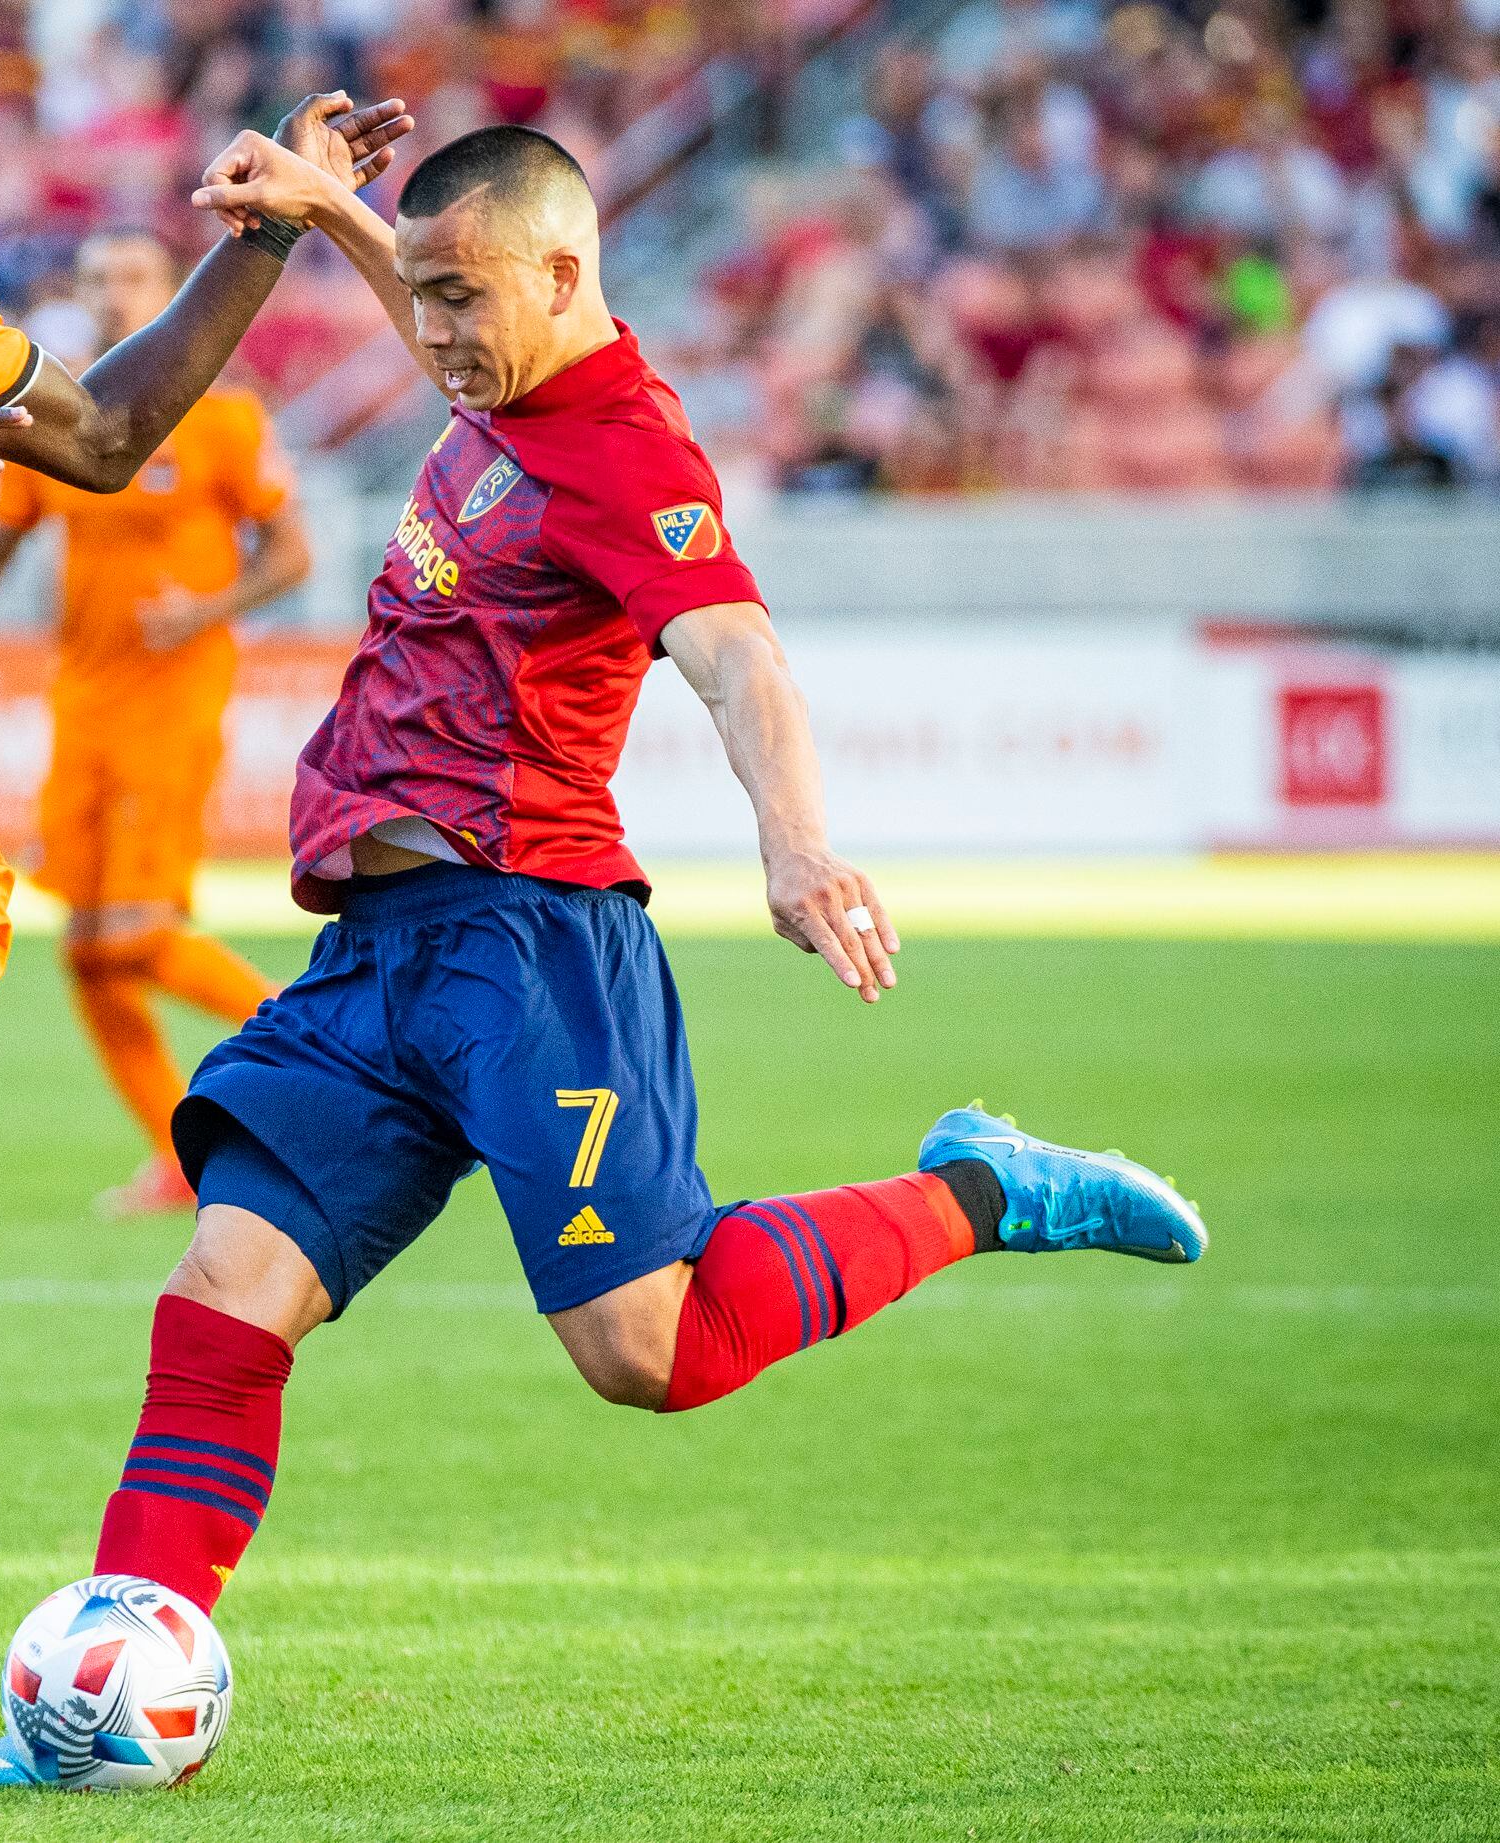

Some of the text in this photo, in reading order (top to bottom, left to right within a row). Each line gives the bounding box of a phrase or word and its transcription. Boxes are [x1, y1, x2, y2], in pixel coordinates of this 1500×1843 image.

[659, 510, 694, 531] MLS
[555, 1088, 620, 1188] 7
[557, 1230, 615, 1247] adidas
